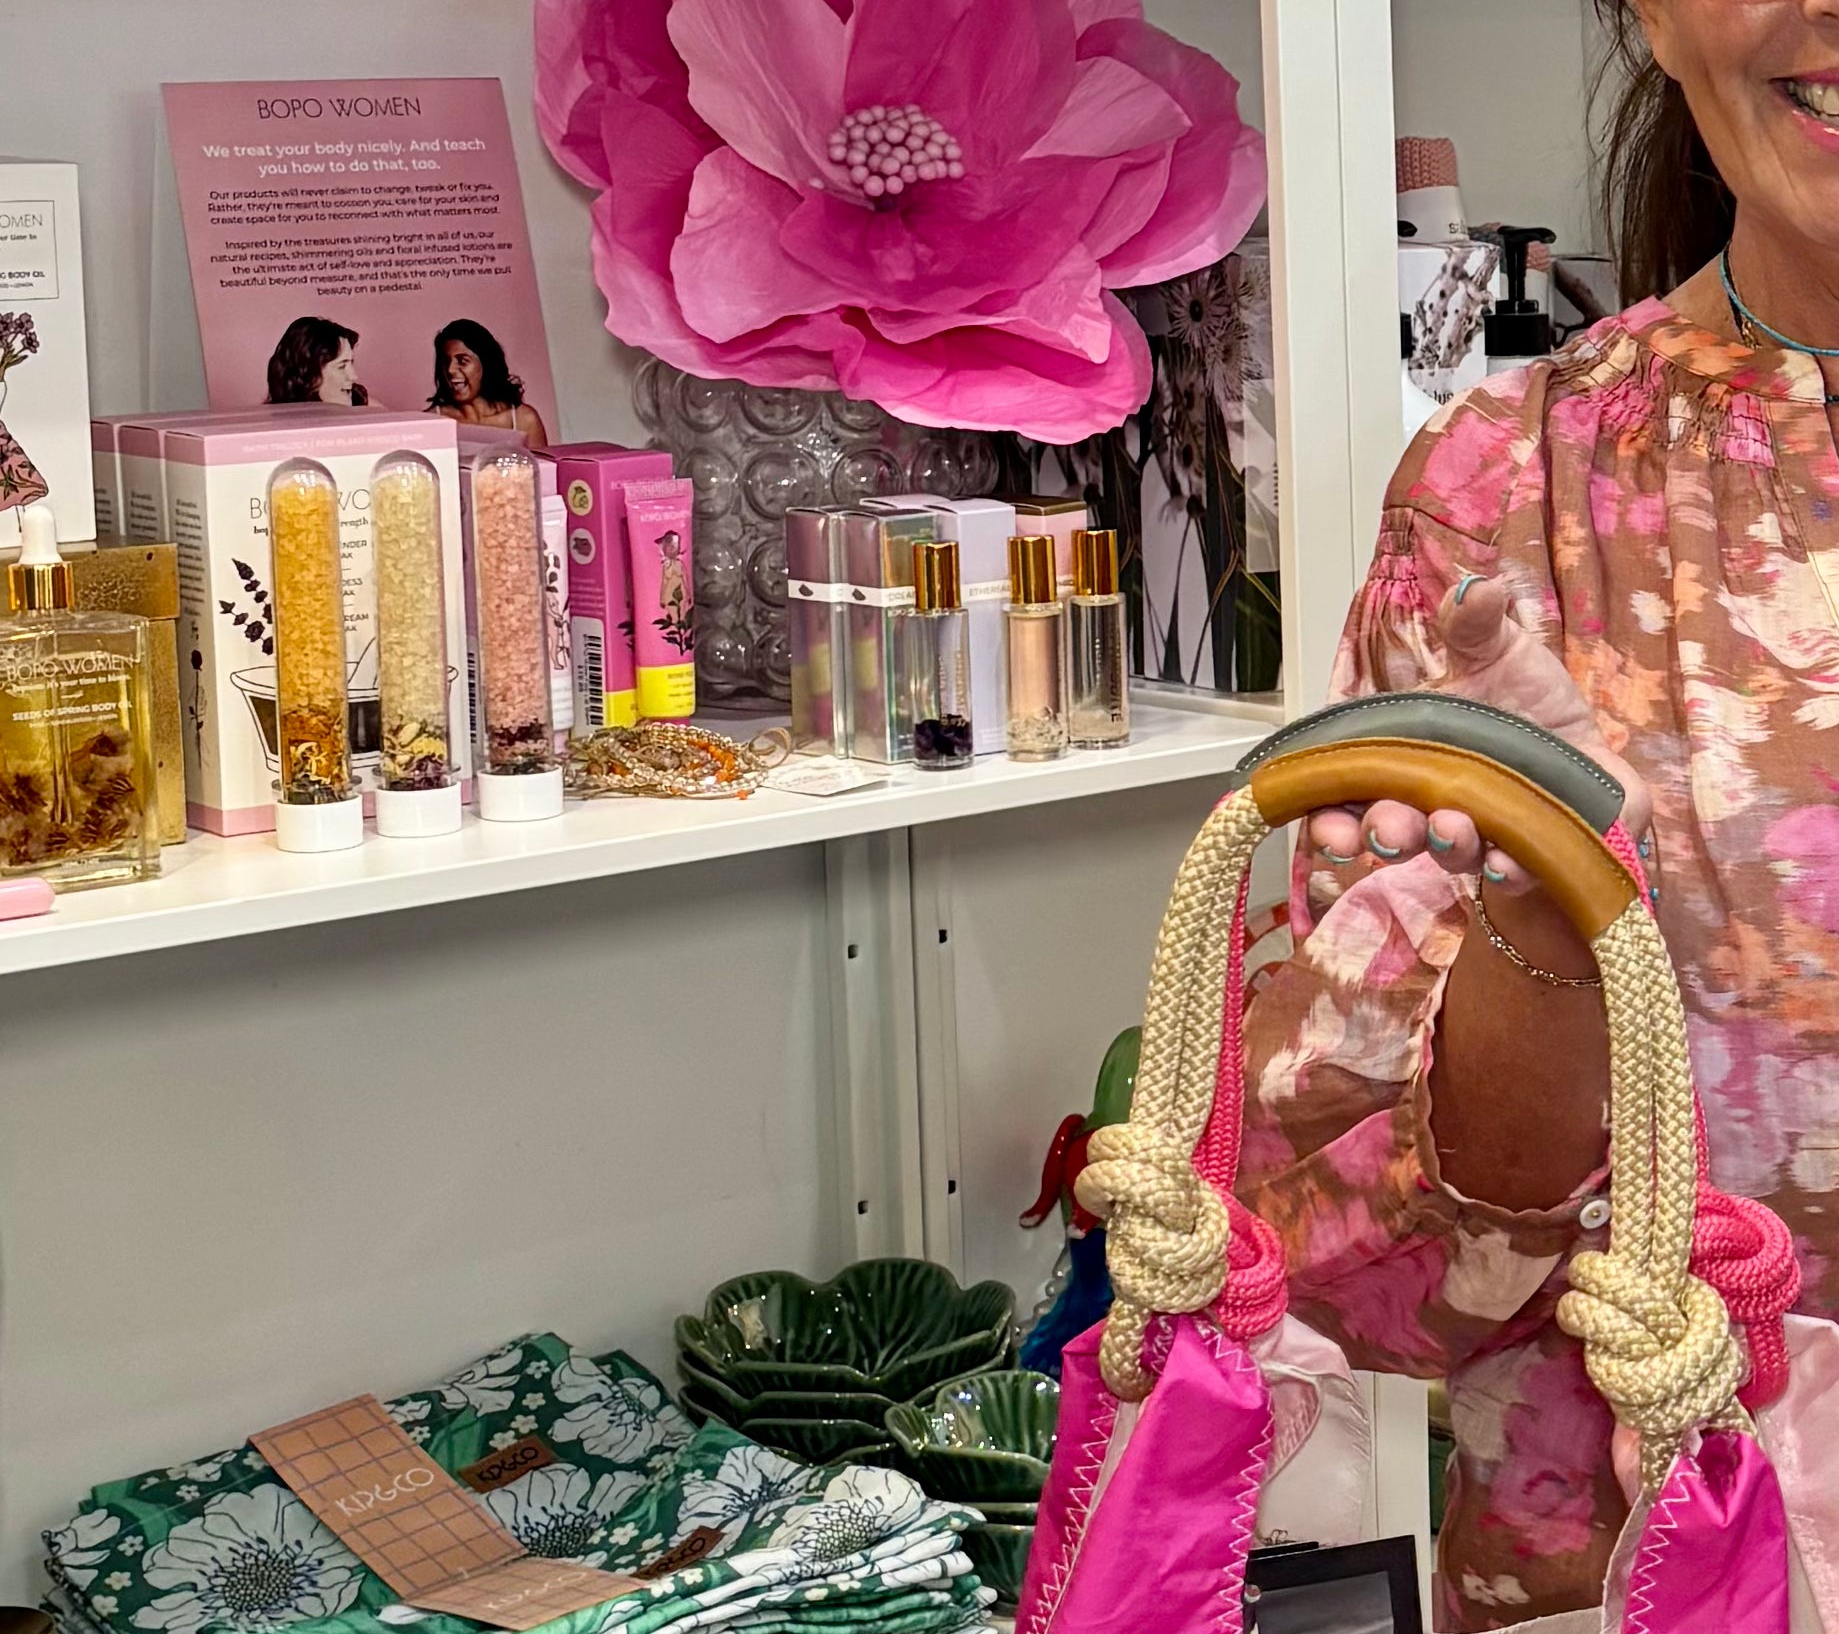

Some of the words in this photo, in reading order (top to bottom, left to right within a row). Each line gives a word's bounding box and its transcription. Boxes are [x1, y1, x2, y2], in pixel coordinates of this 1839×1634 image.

[257, 98, 323, 119] BOPO
[329, 97, 421, 118] WOMEN
[203, 145, 231, 158] We
[234, 143, 274, 157] treat
[275, 143, 313, 157] your
[314, 140, 353, 157] body
[358, 139, 406, 155] nicely.
[410, 138, 440, 153] And
[444, 137, 486, 152] teach
[258, 164, 288, 178] you
[292, 161, 327, 175] how
[329, 160, 345, 174] to
[349, 158, 369, 172] do
[373, 158, 409, 174] that,
[412, 158, 441, 171] too.
[210, 191, 229, 200] Our
[232, 190, 279, 200] products
[281, 188, 299, 197] will
[361, 187, 371, 195] to
[447, 184, 457, 192] or
[285, 200, 319, 210] meant
[321, 200, 332, 209] to
[333, 199, 372, 208] cocoon
[395, 197, 417, 205] care
[419, 196, 432, 204] for
[433, 196, 456, 206] your
[480, 194, 500, 203] and
[0, 214, 43, 228] OMEN
[210, 217, 243, 225] create
[246, 215, 276, 225] space
[278, 213, 292, 223] for
[294, 214, 313, 224] you
[316, 212, 326, 221] to
[328, 210, 379, 221] reconnect
[406, 208, 431, 217] what
[225, 239, 268, 250] Inspired
[269, 238, 282, 249] by
[284, 238, 302, 247] the
[304, 237, 352, 246] treasures
[353, 234, 390, 244] shining
[393, 232, 423, 243] bright
[426, 232, 435, 241] in
[437, 231, 449, 240] all
[451, 231, 461, 240] of
[210, 253, 248, 263] natural
[291, 249, 354, 260] shimmering
[375, 246, 394, 255] and
[424, 243, 460, 253] infused
[497, 242, 513, 250] are
[232, 265, 250, 275] the
[253, 263, 297, 274] ultimate
[299, 263, 314, 272] act
[317, 261, 327, 271] of
[373, 258, 392, 268] and
[220, 276, 266, 288] beautiful
[269, 275, 308, 286] beyond
[358, 271, 378, 281] and
[410, 269, 427, 278] the
[429, 268, 450, 279] only
[452, 267, 475, 276] time
[317, 285, 352, 296] beauty
[354, 285, 368, 294] on
[369, 285, 376, 293] a
[6, 661, 58, 682] BOPO
[62, 653, 134, 675] WOMEN
